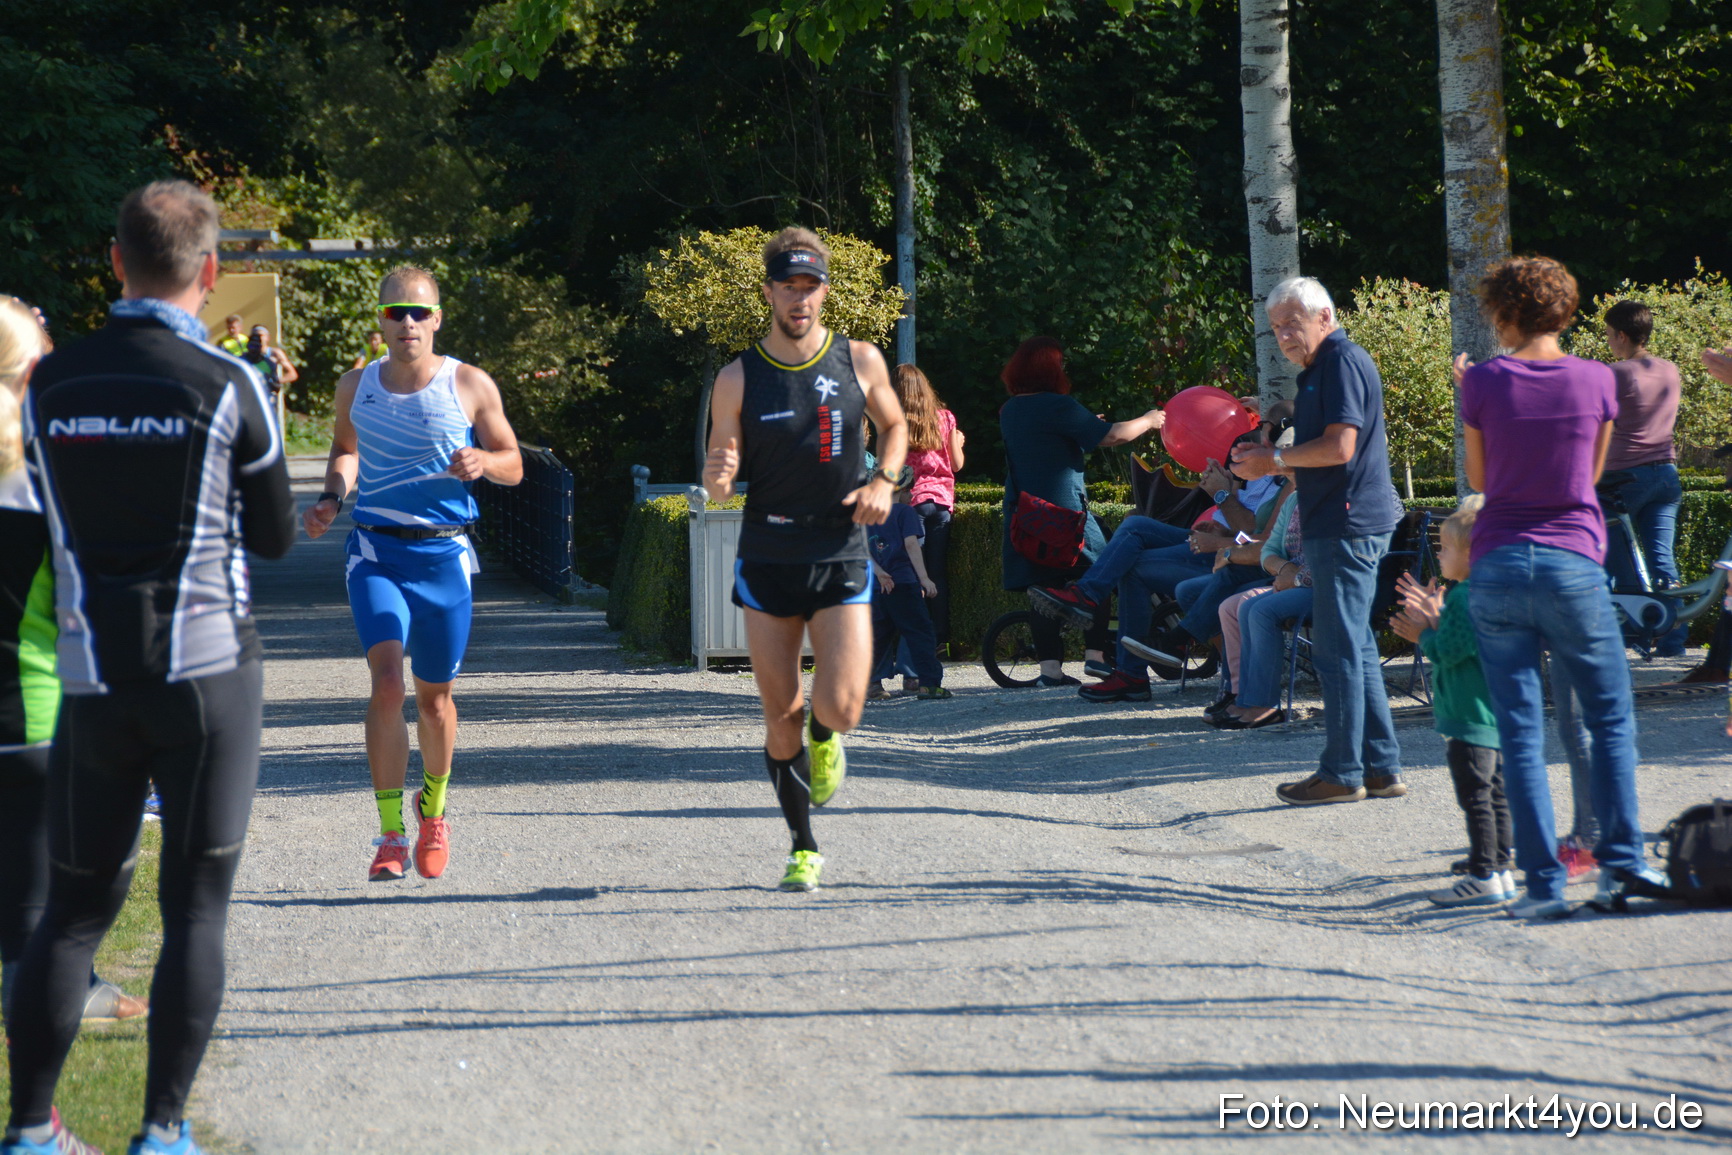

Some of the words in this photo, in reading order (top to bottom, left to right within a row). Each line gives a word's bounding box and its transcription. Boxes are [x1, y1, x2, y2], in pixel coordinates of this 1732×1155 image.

[817, 405, 832, 430] ROTH
[820, 431, 832, 445] 08
[830, 410, 843, 456] TRIATHLON
[819, 446, 832, 463] TSG
